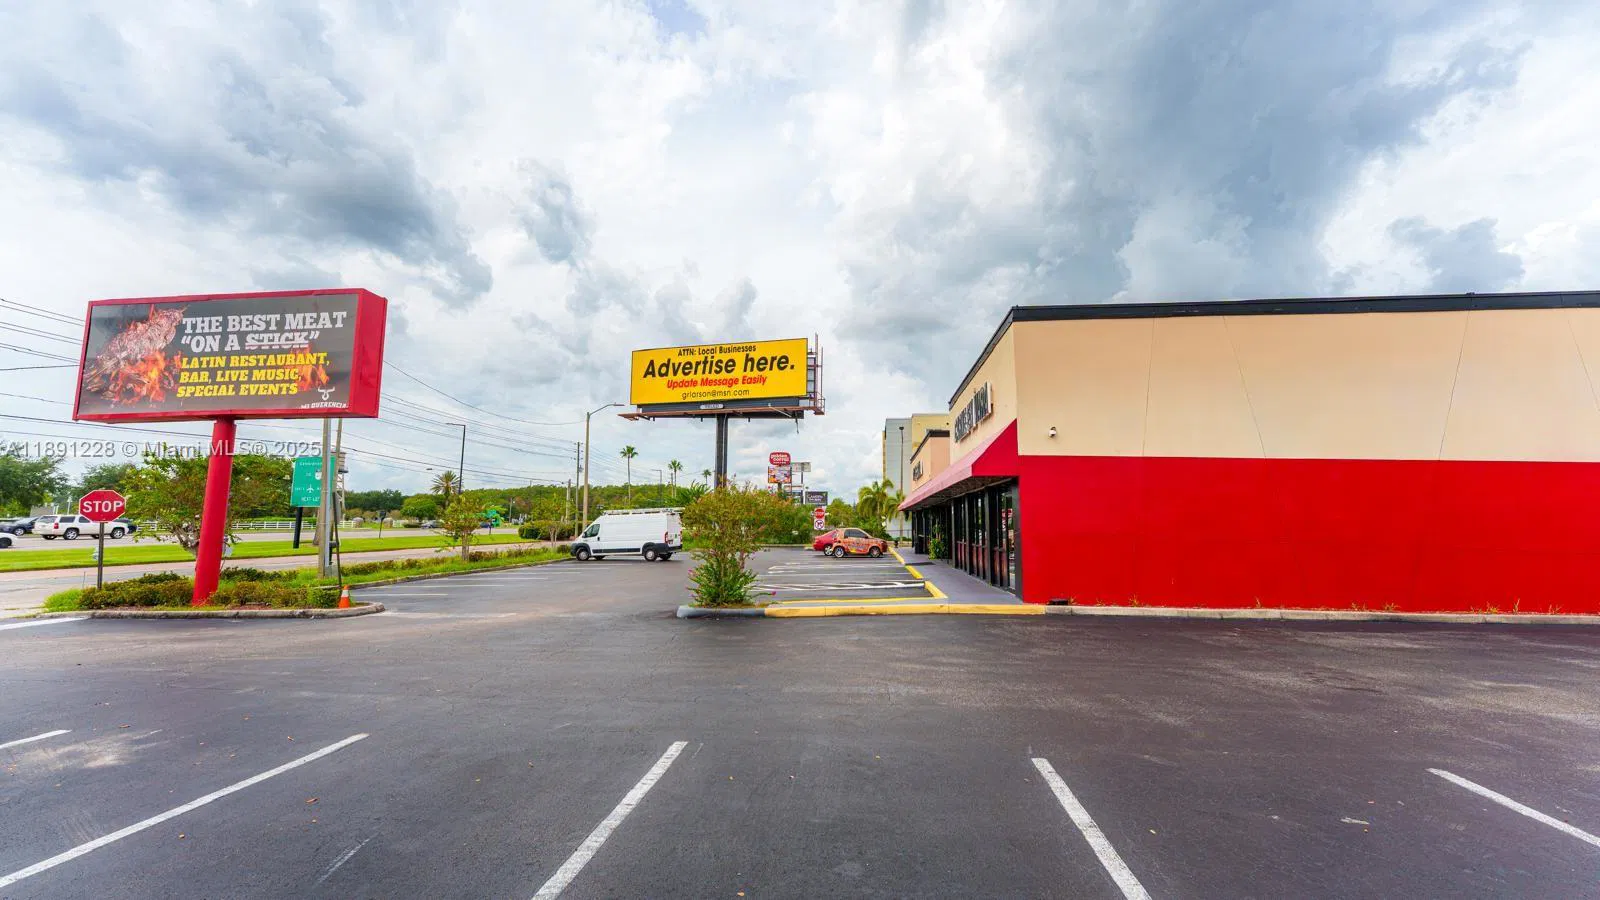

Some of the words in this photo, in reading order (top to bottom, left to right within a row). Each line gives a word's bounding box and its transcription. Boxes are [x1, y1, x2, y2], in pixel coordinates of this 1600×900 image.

[182, 316, 222, 333] THE
[227, 314, 280, 331] BEST
[285, 311, 347, 330] MEAT
[225, 334, 240, 351] A
[678, 348, 696, 356] ATTN:
[699, 347, 716, 355] Local
[719, 345, 756, 353] Businesses
[181, 356, 226, 369] LATIN
[229, 352, 330, 367] RESTAURANT,
[643, 356, 736, 378] Advertise
[744, 353, 795, 372] here.
[179, 371, 211, 384] BAR,
[215, 369, 249, 382] LIVE
[252, 368, 302, 381] MUSIC,
[667, 379, 698, 390] Update
[700, 376, 739, 388] Message
[741, 375, 767, 385] Easily
[176, 384, 236, 397] SPECIAL
[239, 382, 298, 396] EVENTS
[82, 500, 124, 513] STOP
